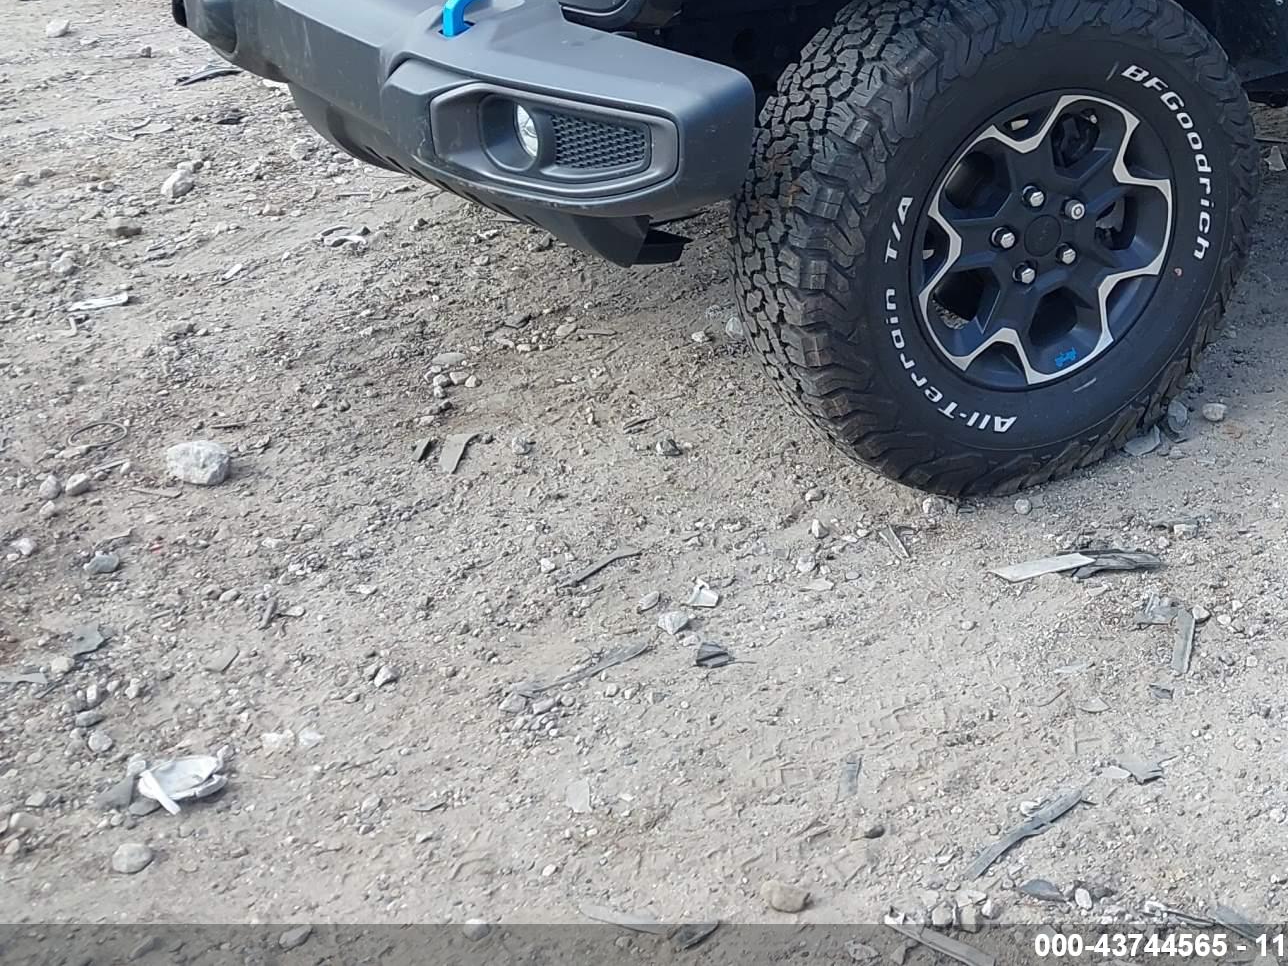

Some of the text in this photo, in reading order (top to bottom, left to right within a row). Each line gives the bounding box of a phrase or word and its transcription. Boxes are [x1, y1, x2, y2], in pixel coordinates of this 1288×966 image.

[1121, 64, 1216, 261] BFGoodrich
[884, 196, 1018, 433] All-Terrain T/A
